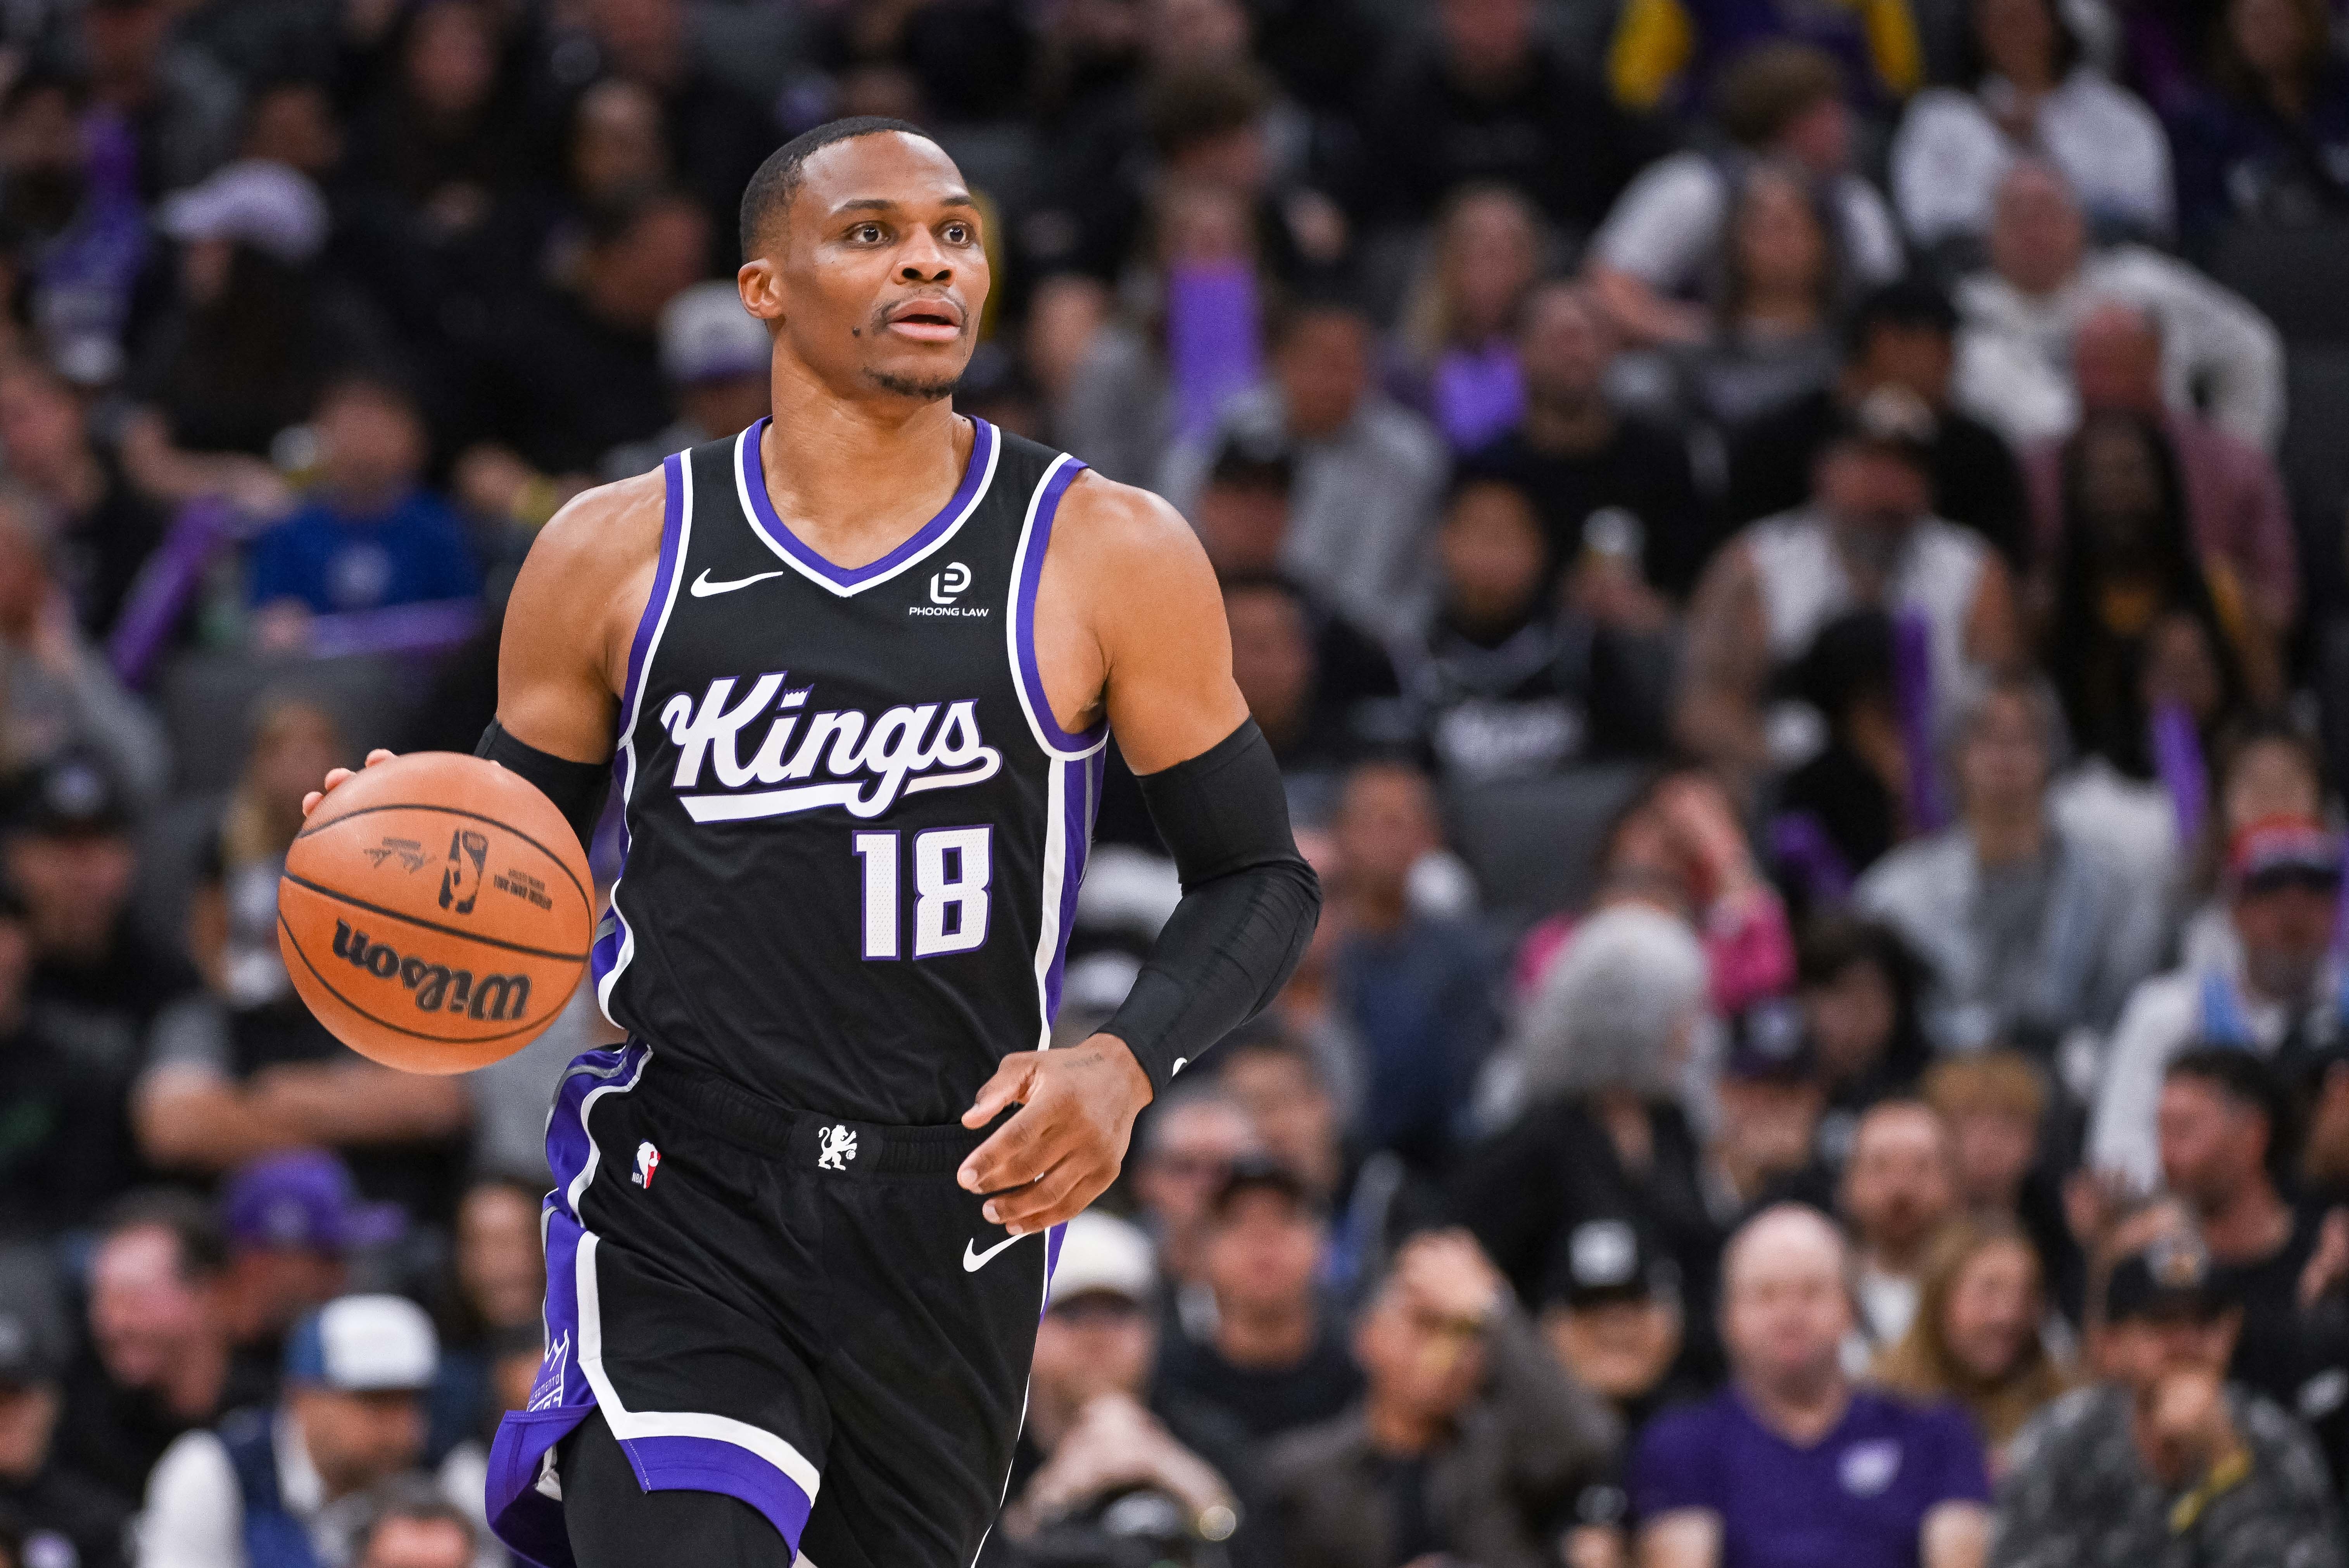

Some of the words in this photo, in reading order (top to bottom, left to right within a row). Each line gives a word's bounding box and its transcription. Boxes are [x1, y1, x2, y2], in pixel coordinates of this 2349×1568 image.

[909, 607, 959, 616] PHOONG
[962, 608, 989, 616] LAW
[660, 671, 1003, 824] Kings
[853, 824, 994, 961] 18
[332, 917, 532, 1020] Wilson
[632, 1172, 643, 1185] NBA
